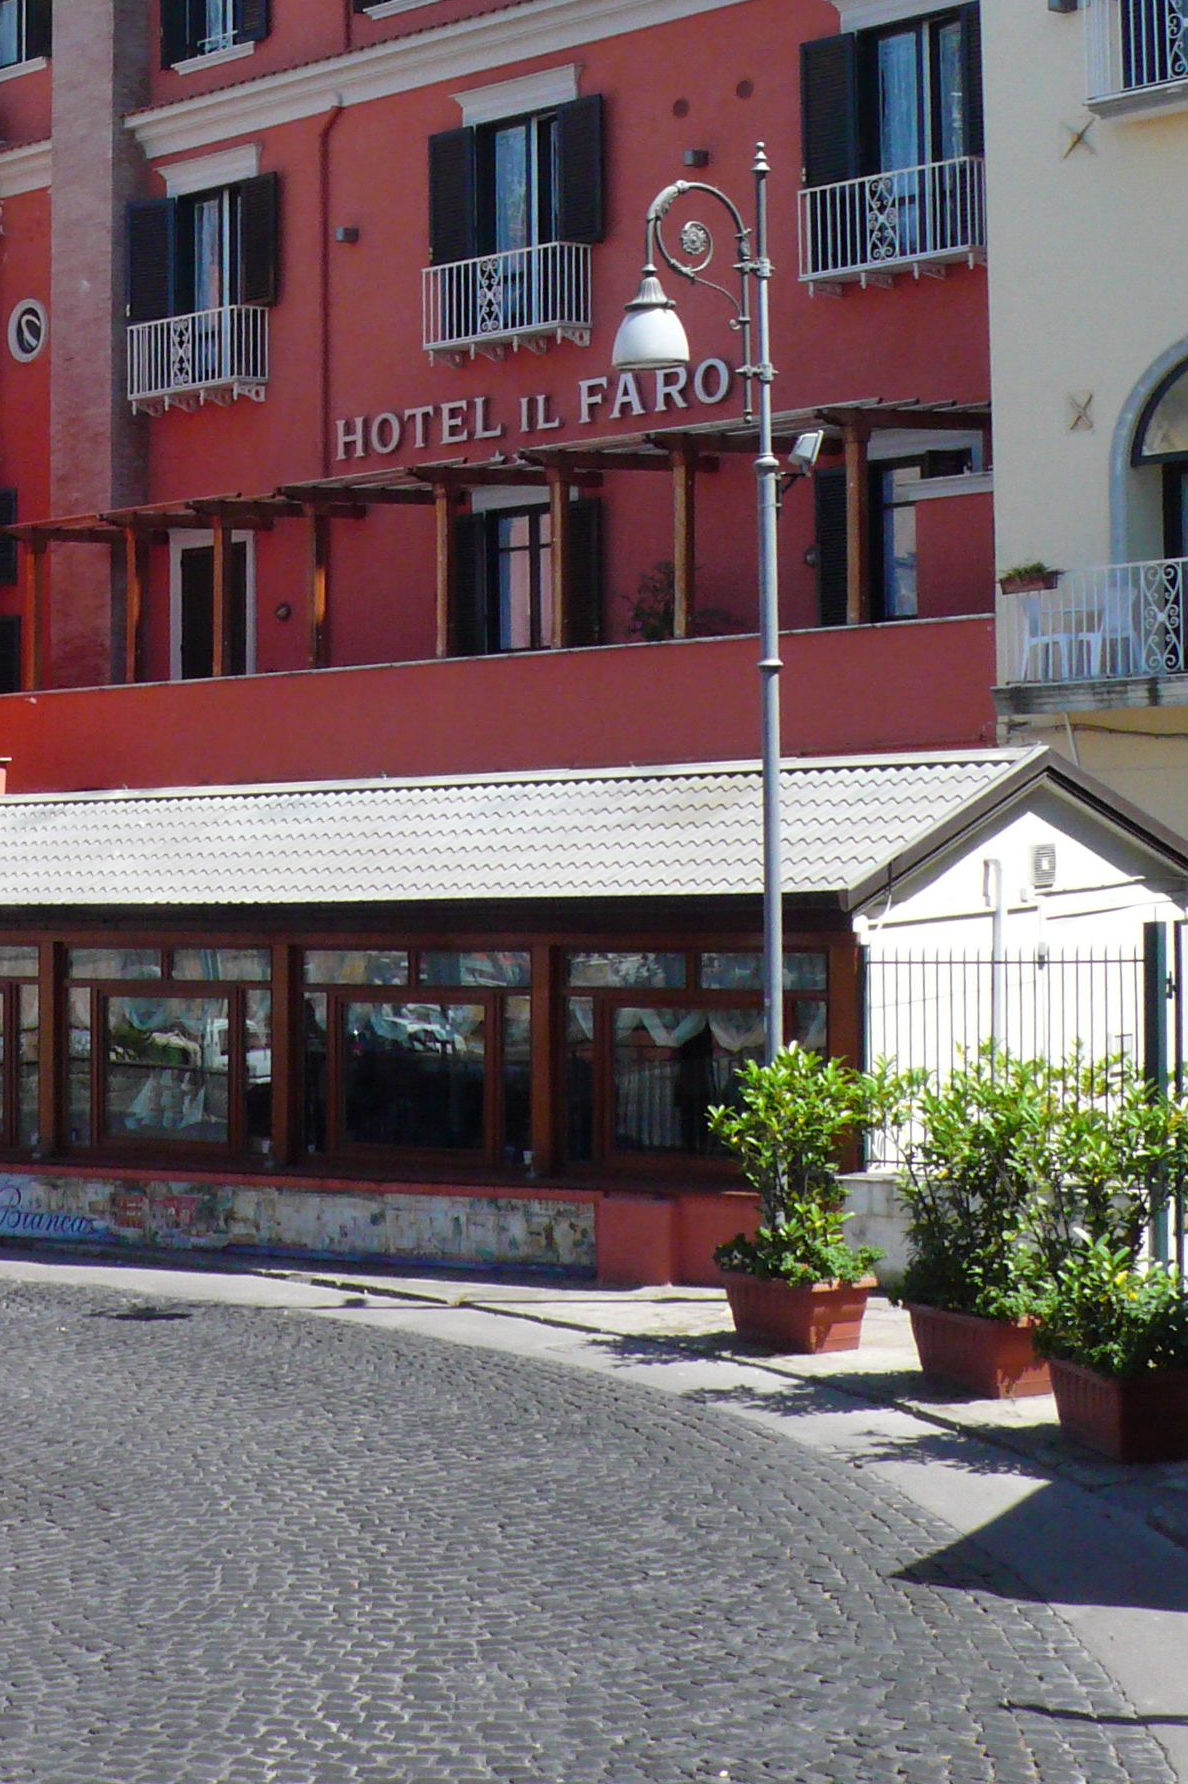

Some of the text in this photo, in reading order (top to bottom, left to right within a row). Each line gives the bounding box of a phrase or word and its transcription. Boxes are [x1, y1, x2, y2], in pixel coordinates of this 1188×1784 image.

[335, 357, 730, 461] HOTEL IL FARO
